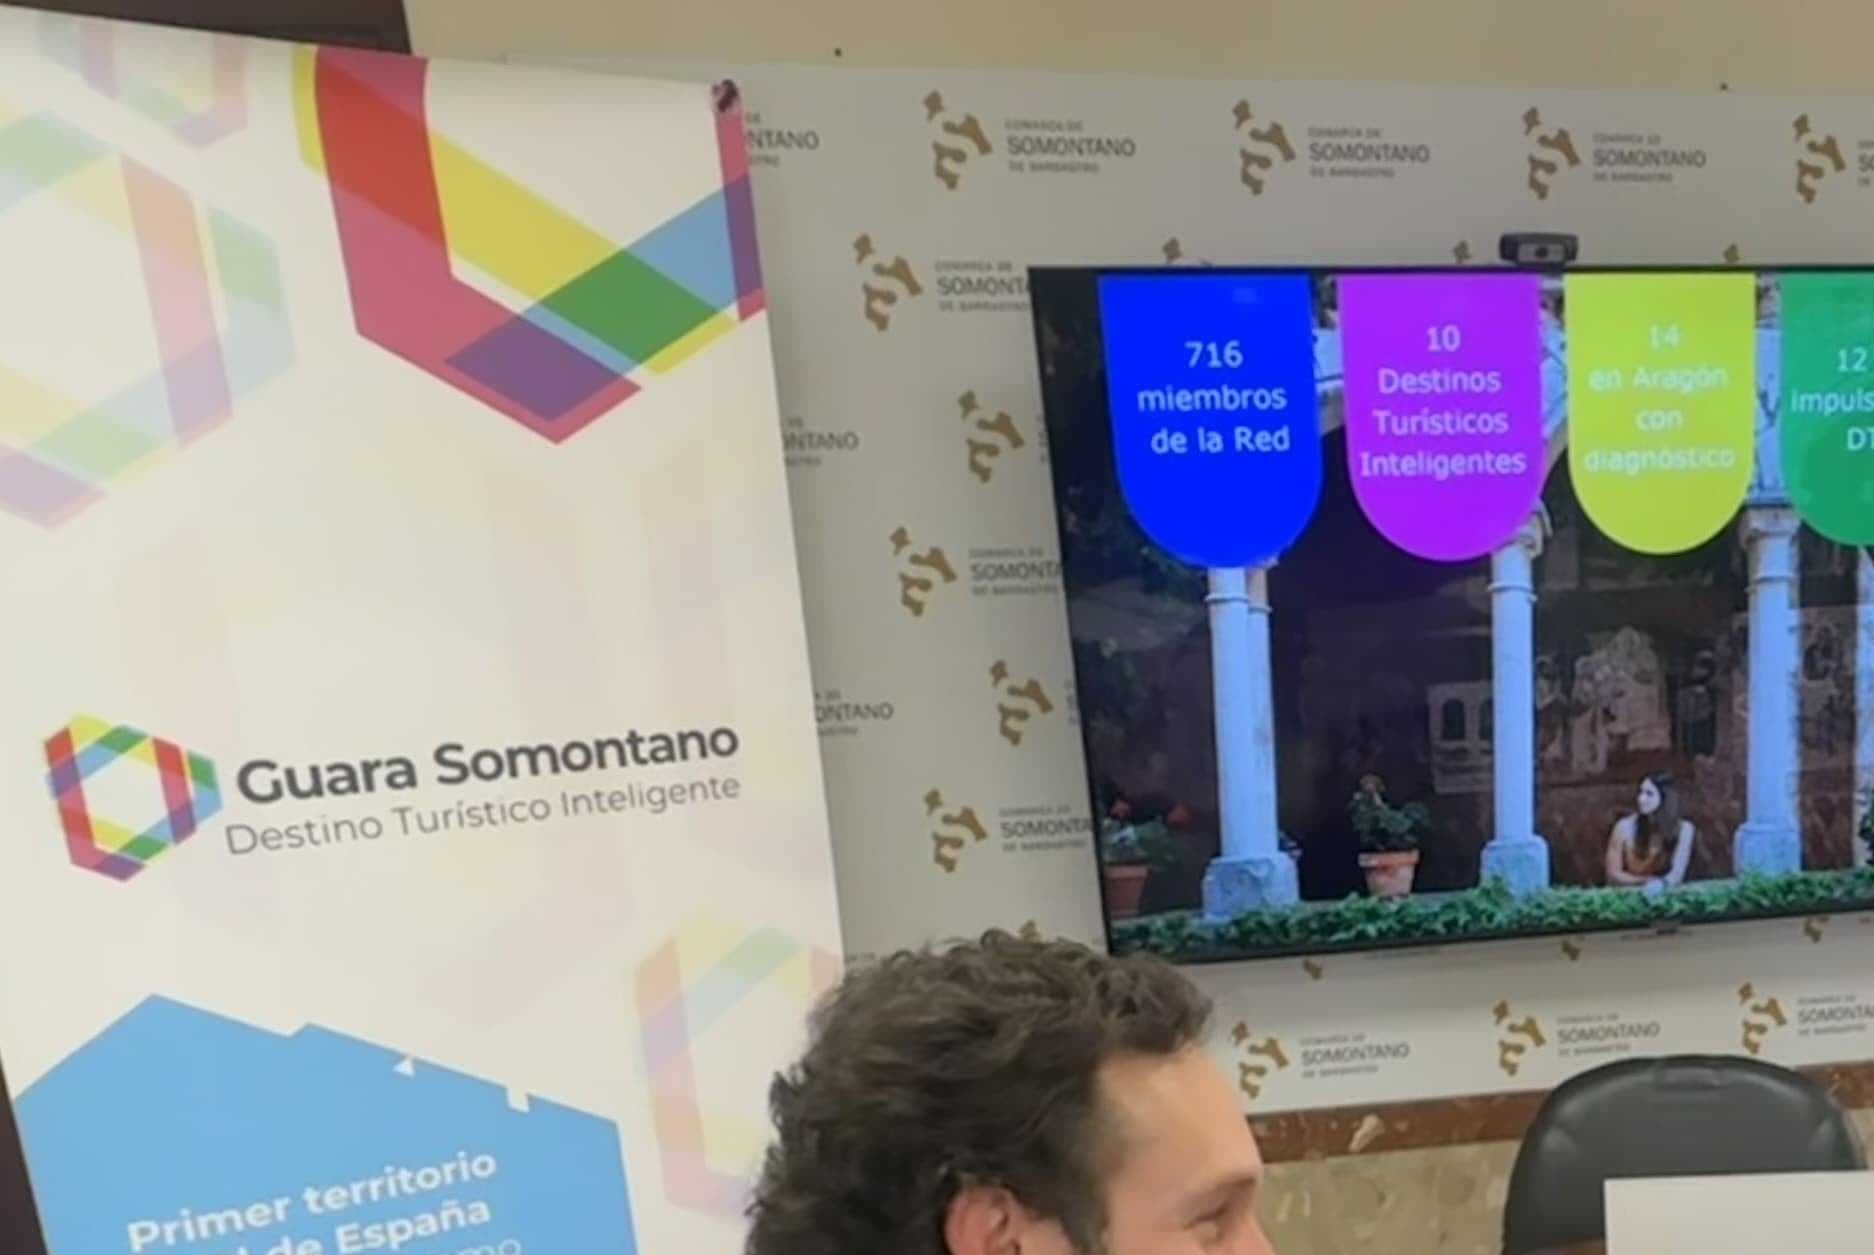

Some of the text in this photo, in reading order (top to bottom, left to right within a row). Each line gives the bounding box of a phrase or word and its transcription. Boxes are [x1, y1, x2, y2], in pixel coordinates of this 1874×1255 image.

[745, 130, 820, 151] NTANO
[1006, 135, 1137, 157] SOMONTANO
[1309, 142, 1431, 163] SOMONTANO
[1592, 148, 1707, 169] SOMONTANO
[936, 275, 1028, 296] SOMONT
[1426, 326, 1461, 352] 10
[1648, 325, 1680, 349] 14
[1184, 341, 1244, 368] 716
[1837, 348, 1868, 372] 12
[1378, 368, 1502, 394] Destinos
[1590, 366, 1728, 396] en Aragón
[1137, 384, 1288, 412] miembros
[1372, 407, 1509, 436] Turísticos
[1636, 410, 1684, 431] con
[1151, 426, 1291, 455] de la Red
[1360, 449, 1528, 481] Inteligentes
[1583, 447, 1736, 475] diagnóstico
[814, 702, 895, 723] ONTANO
[235, 726, 741, 805] Guara Somontano
[225, 774, 741, 857] Destino Turístico Inteligente
[1001, 817, 1094, 838] SOMONTA
[1557, 1021, 1662, 1044] SOMONTANO
[1300, 1041, 1411, 1066] SOMONTANO
[127, 1149, 497, 1254] Primer territorio
[335, 1198, 492, 1255] España
